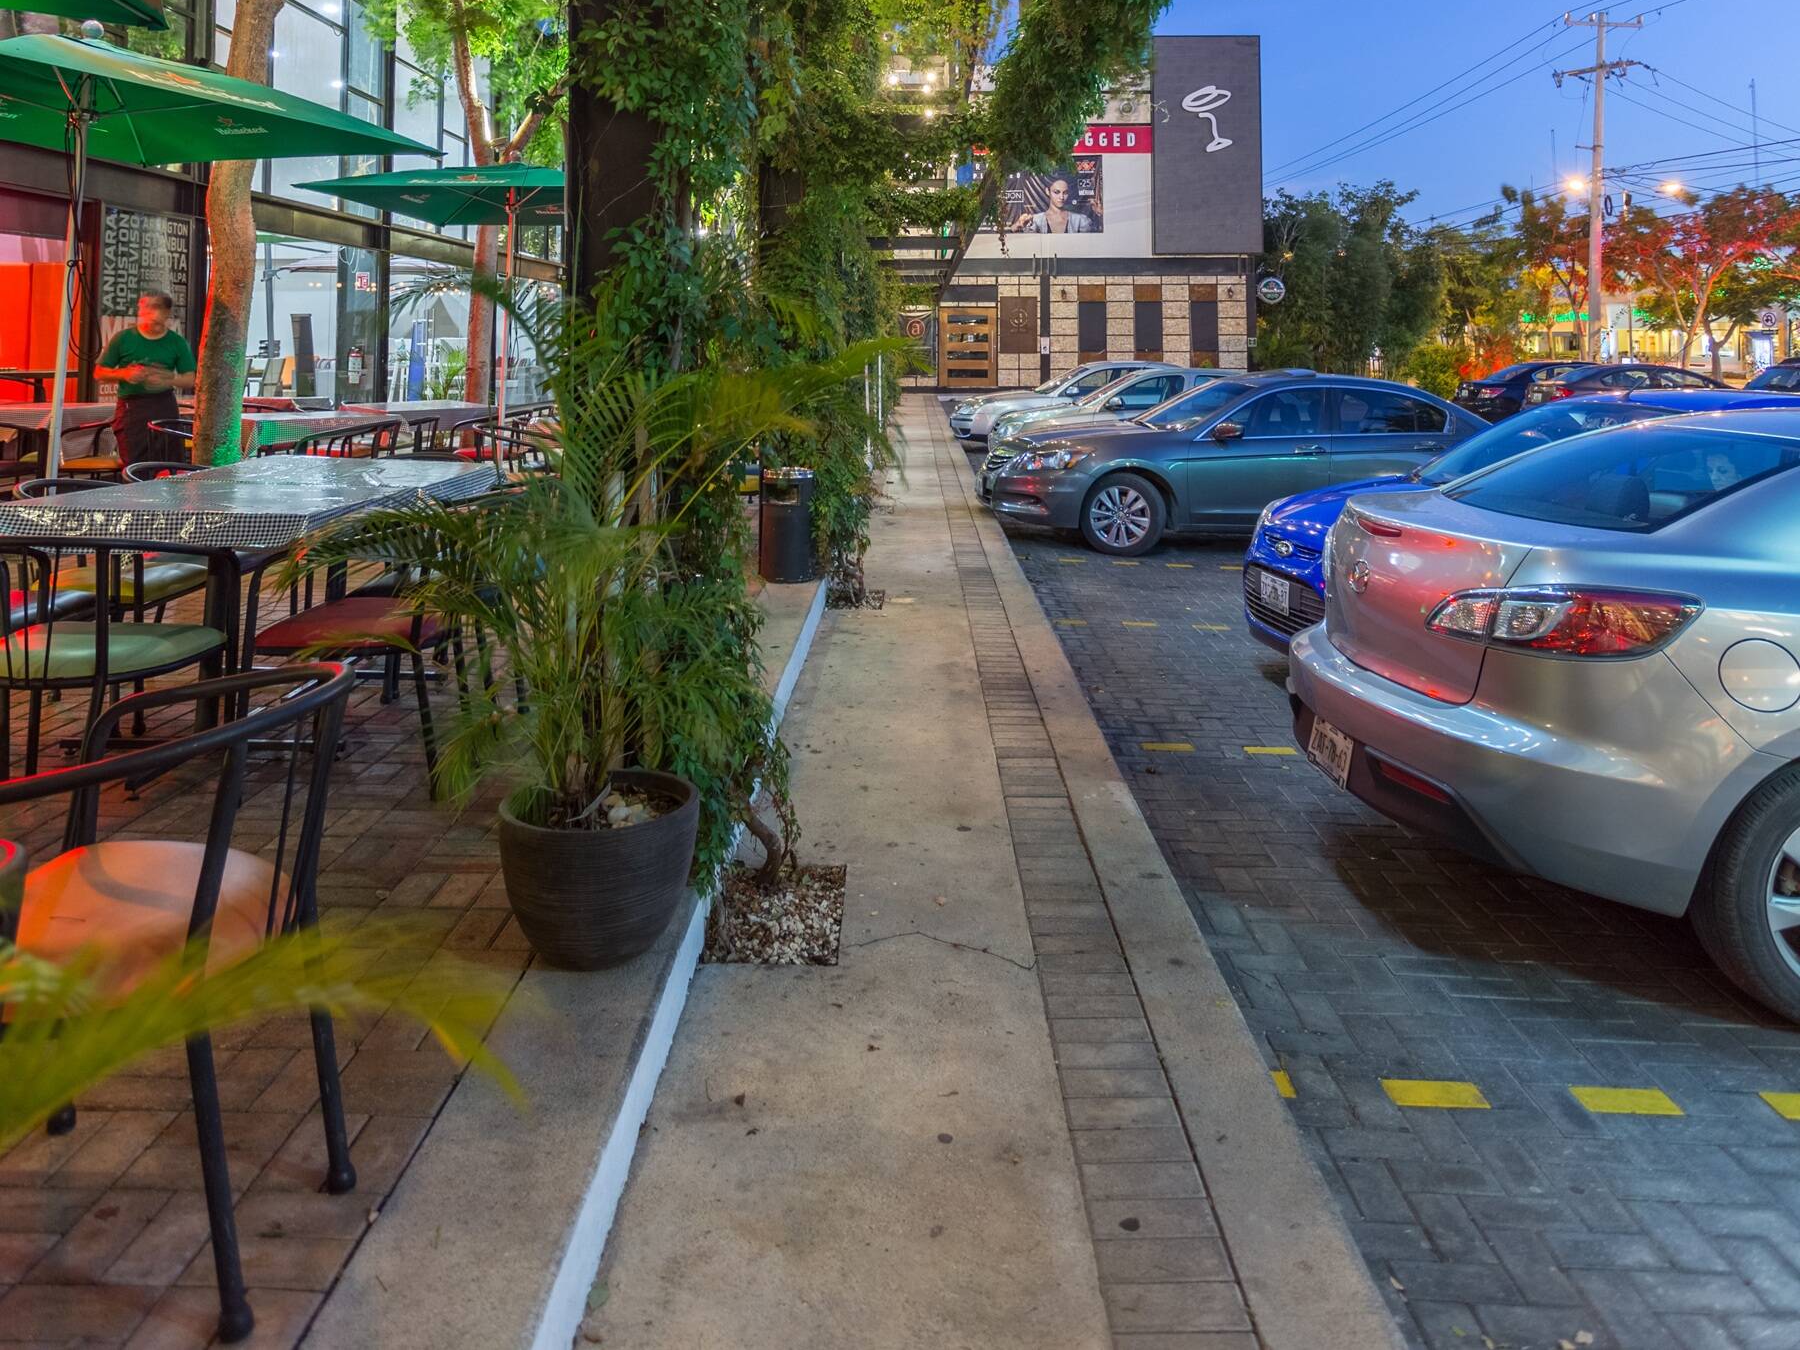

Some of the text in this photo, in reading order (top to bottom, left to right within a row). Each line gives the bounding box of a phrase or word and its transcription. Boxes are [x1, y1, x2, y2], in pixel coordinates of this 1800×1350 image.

[102, 211, 118, 310] ANKARA
[116, 213, 130, 311] HOUSTON
[127, 215, 140, 302] TREVISO
[141, 249, 187, 271] BOGOTA
